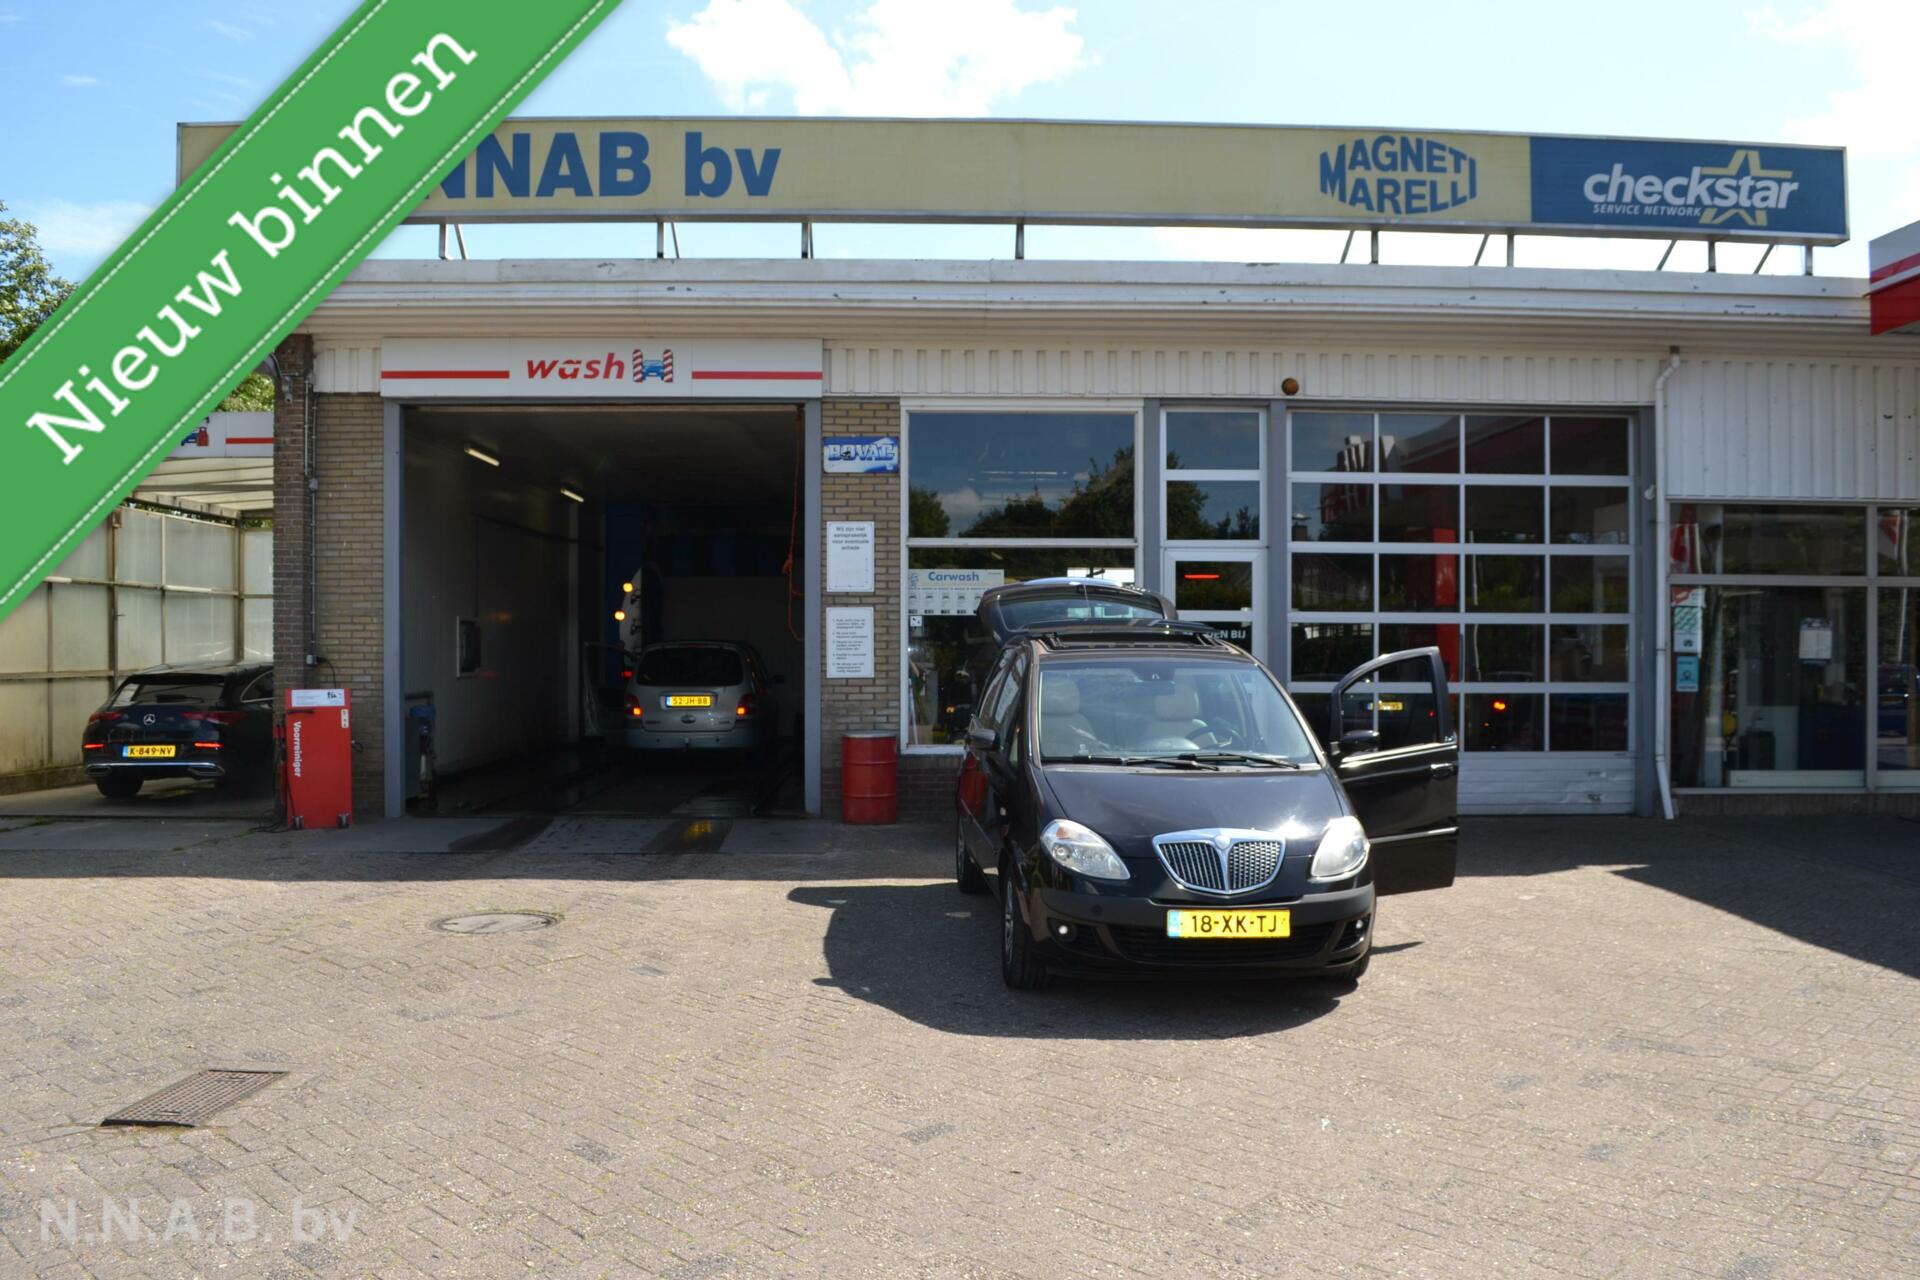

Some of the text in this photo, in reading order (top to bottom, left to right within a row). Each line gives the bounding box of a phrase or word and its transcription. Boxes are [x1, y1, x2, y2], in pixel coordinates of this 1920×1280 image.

[684, 131, 781, 198] bv
[1320, 134, 1477, 180] MAGNETI
[1583, 163, 1799, 209] checkstar
[1593, 204, 1701, 216] SERVICE NETWORK
[527, 352, 625, 380] wash
[928, 571, 980, 582] Carwash
[1231, 630, 1246, 639] BIJ
[130, 746, 173, 756] K-849-NV
[293, 720, 302, 777] Voorreiniger
[1191, 915, 1277, 933] 18-XK-TJ
